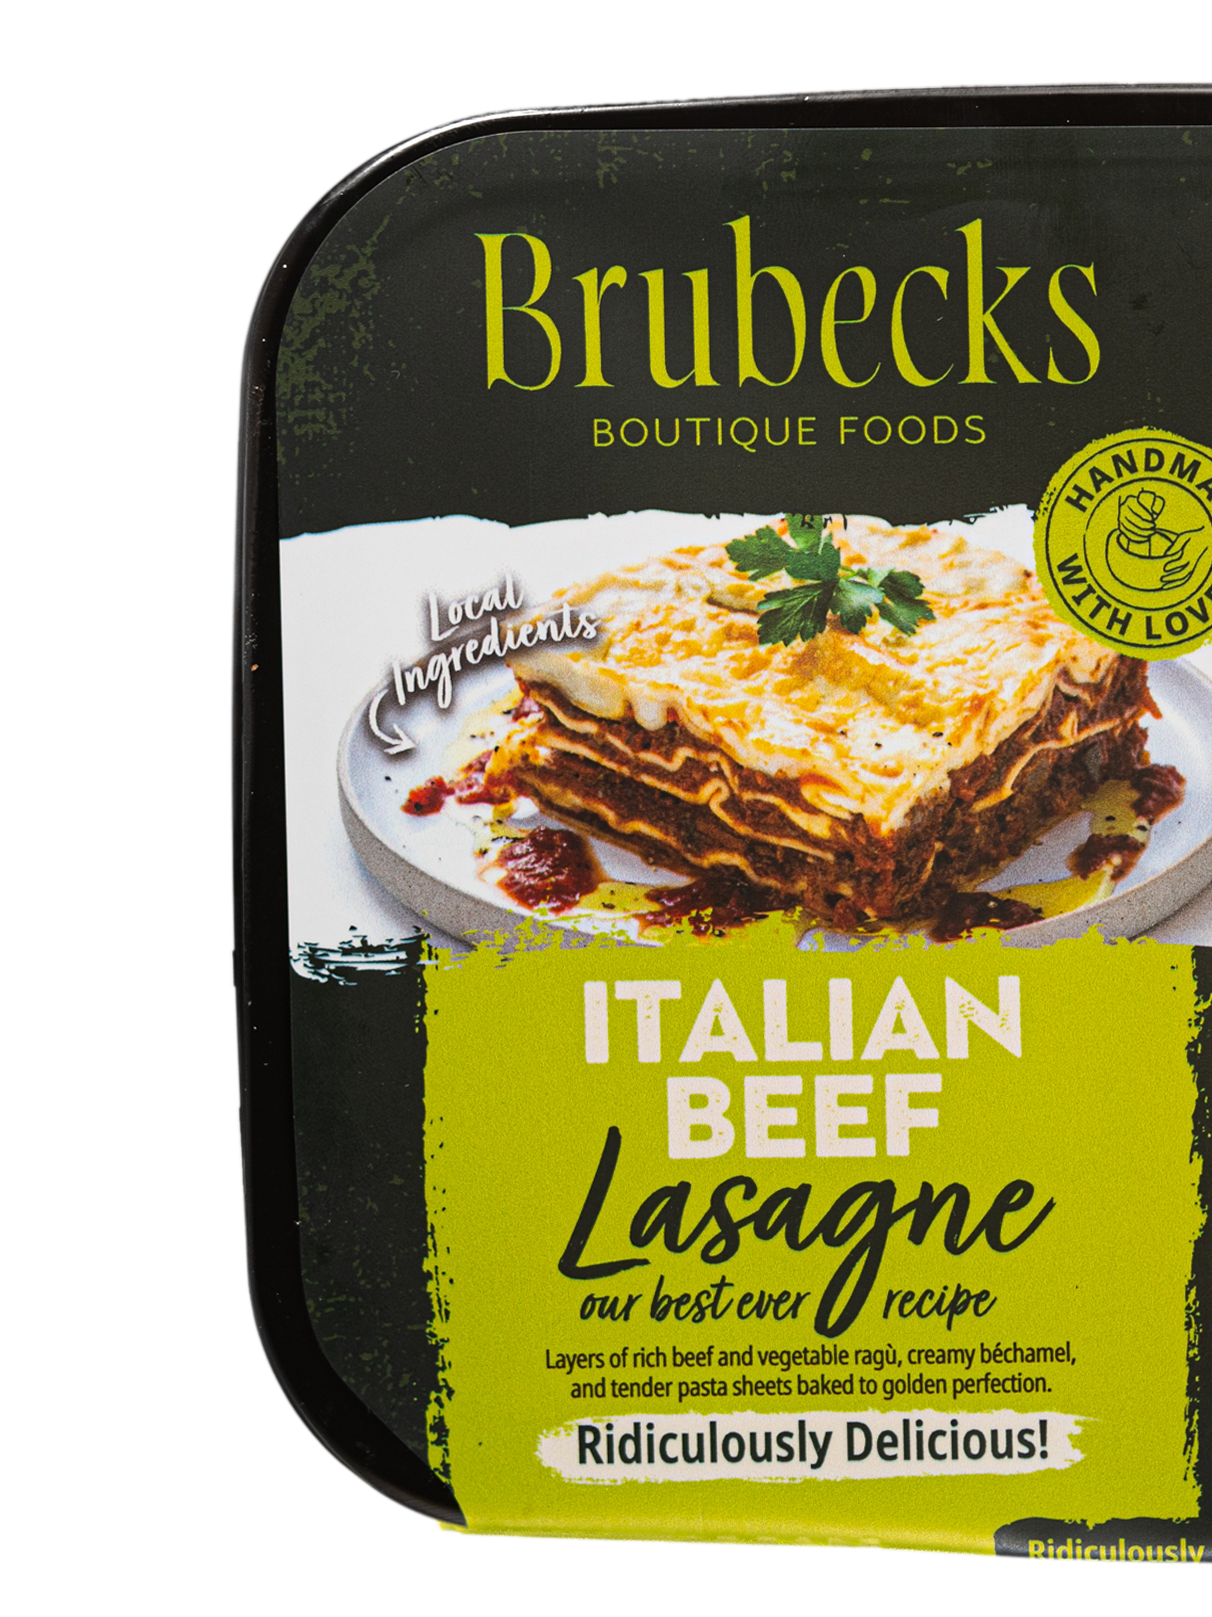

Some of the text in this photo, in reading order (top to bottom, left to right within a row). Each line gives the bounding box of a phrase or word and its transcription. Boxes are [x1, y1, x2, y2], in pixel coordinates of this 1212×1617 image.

[473, 214, 1101, 391] Brubecks
[593, 415, 988, 453] BOUTIQUE FOODS
[429, 572, 524, 641] Local
[1056, 553, 1133, 636] WITH
[391, 602, 602, 709] Ingredients
[583, 974, 1023, 1064] ITALIAN
[665, 1072, 944, 1160] BEEF
[557, 1125, 1057, 1338] Lasagne
[579, 1274, 998, 1331] our best ever recipe
[545, 1341, 1076, 1375] Layers of rich beef and vegetable ragù, creamy béchamel,
[570, 1371, 1052, 1403] and tender pasta sheets baked to golden perfection.
[577, 1418, 1049, 1470] Ridiculously Delicious!
[1028, 1538, 1205, 1565] Ridiculously
